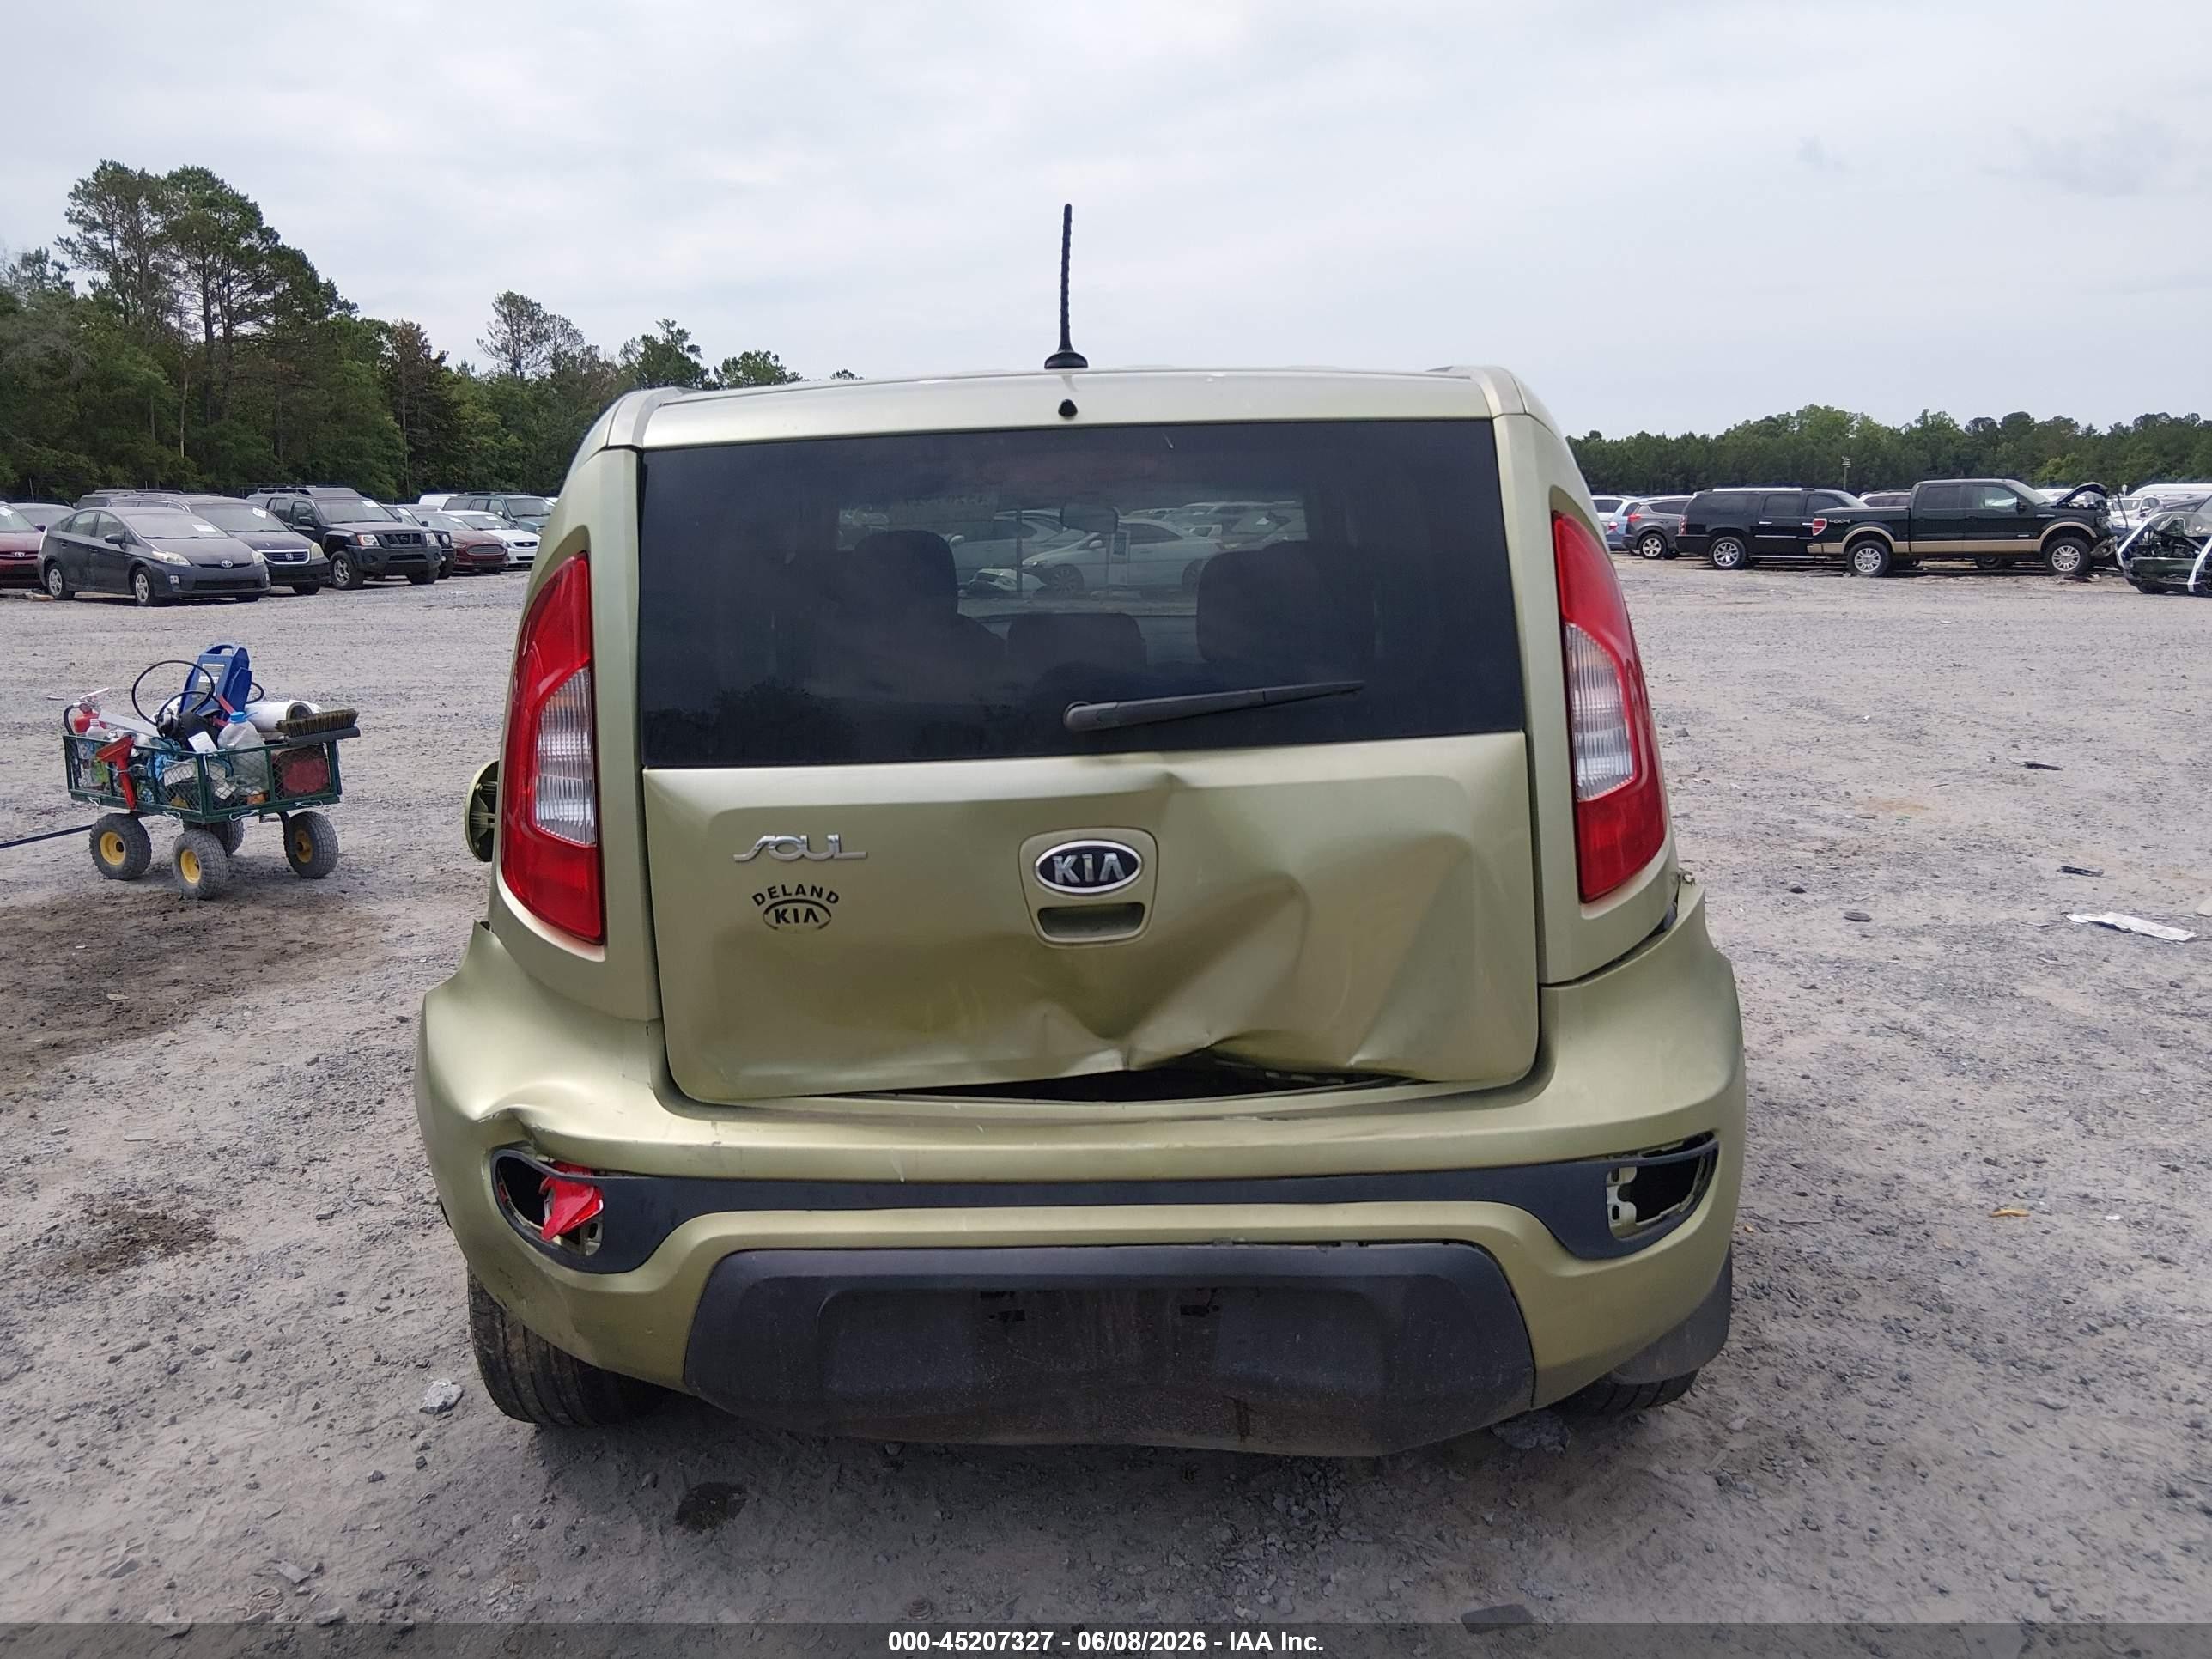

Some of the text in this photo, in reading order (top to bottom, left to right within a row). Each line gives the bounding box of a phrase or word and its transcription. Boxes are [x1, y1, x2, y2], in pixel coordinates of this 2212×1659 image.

[733, 834, 867, 862] SOUL
[1052, 853, 1126, 884] KIA
[752, 884, 839, 906] DELAND
[775, 908, 819, 924] KIA
